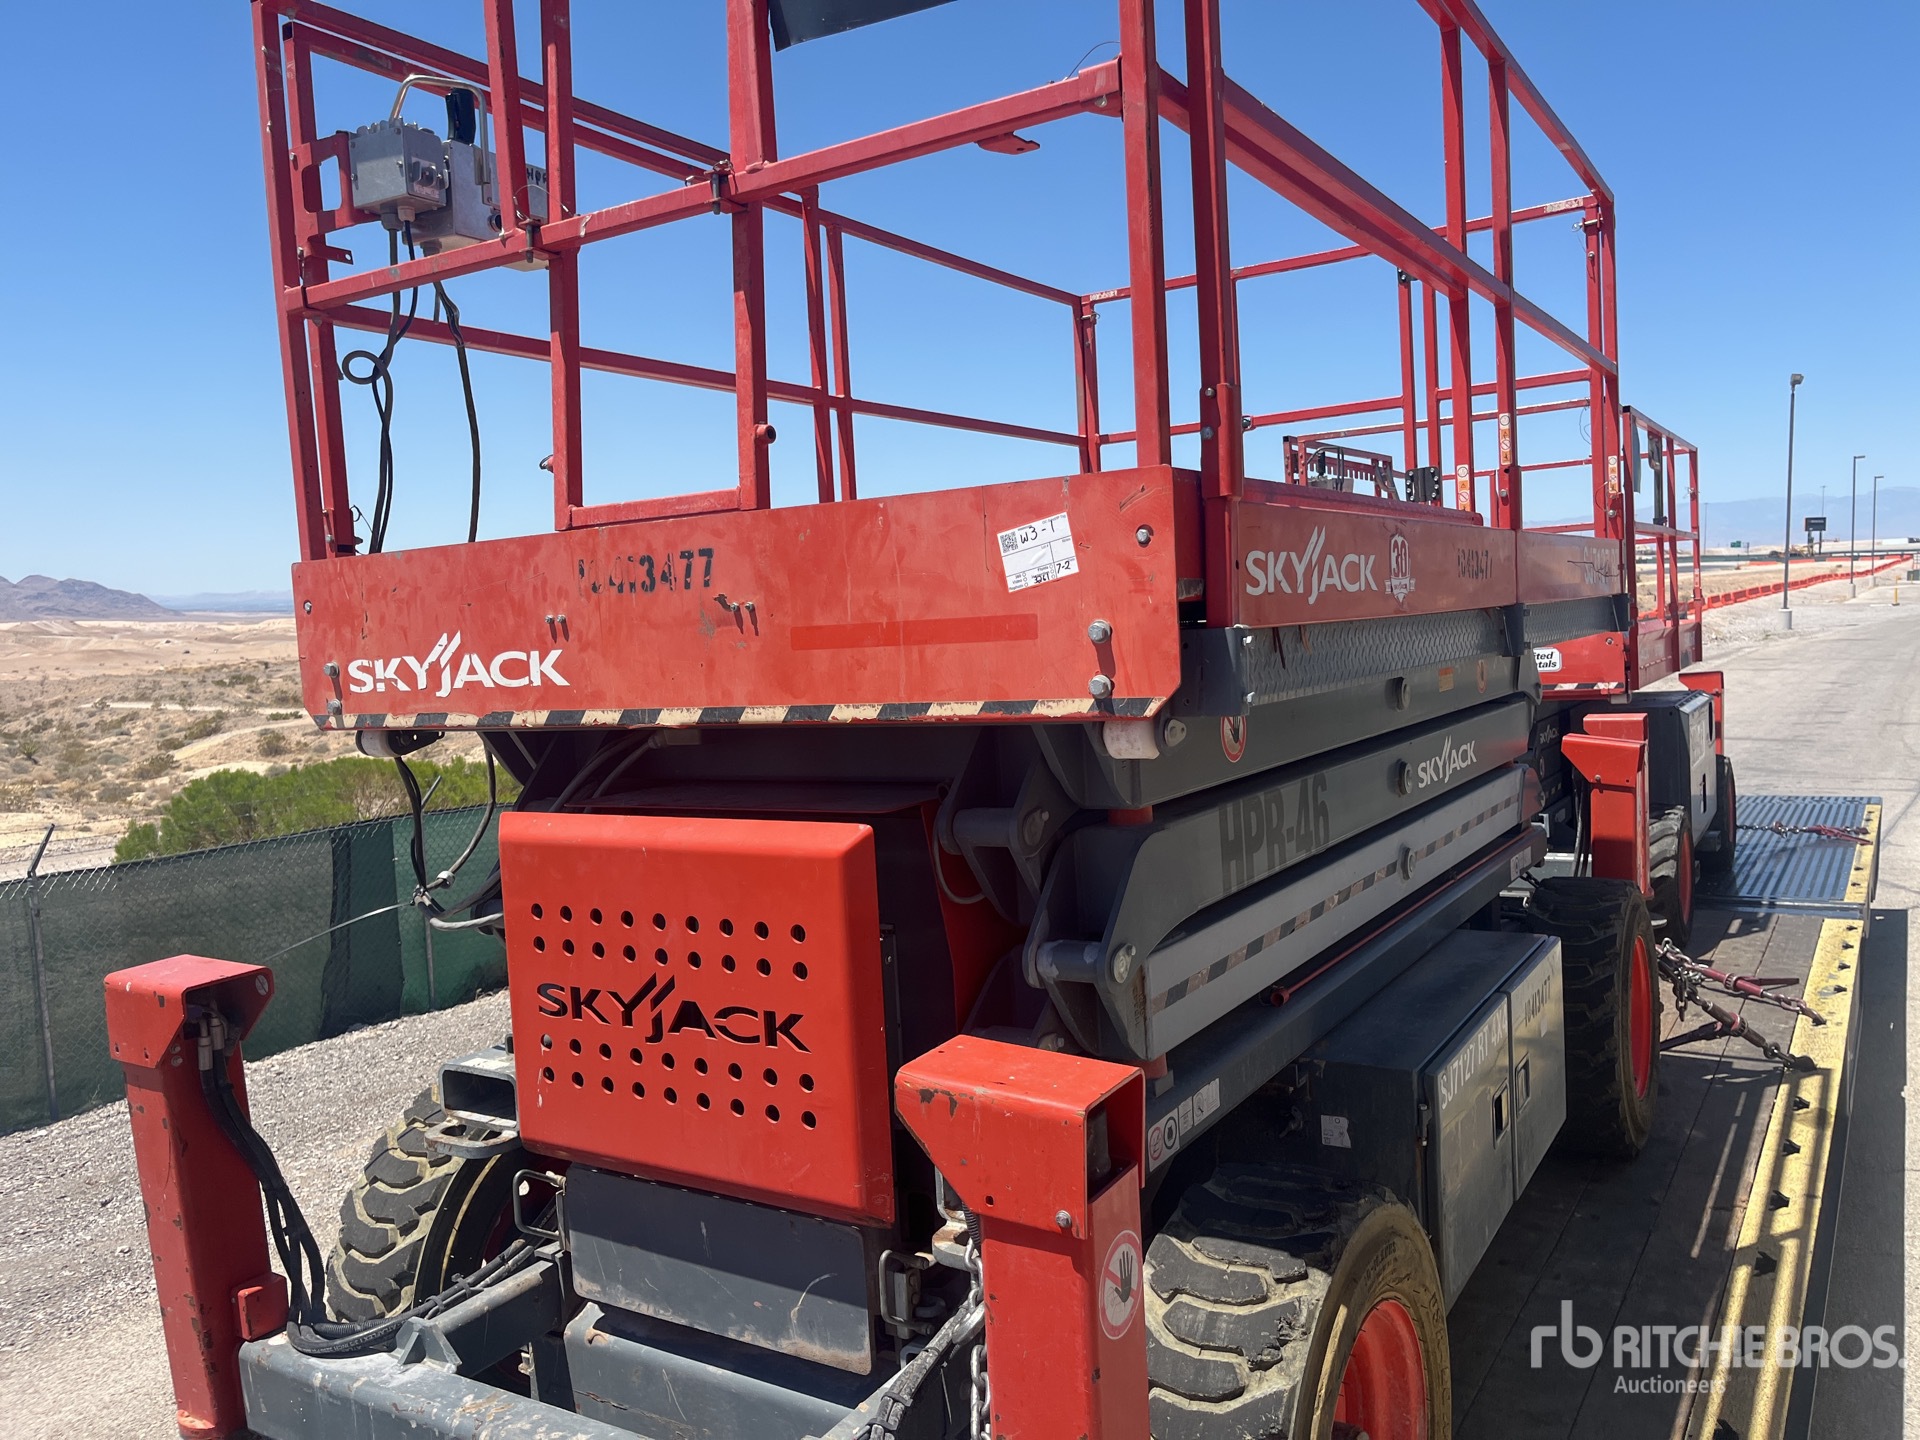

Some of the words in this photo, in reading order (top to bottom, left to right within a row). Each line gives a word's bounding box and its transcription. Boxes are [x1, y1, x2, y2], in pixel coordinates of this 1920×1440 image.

[1245, 525, 1378, 605] SKYJACK
[347, 629, 571, 698] SKYJACK
[1534, 651, 1554, 660] ted
[1417, 735, 1477, 789] SKYJACK
[1218, 771, 1330, 896] HPR-46
[536, 971, 812, 1054] SKYJACK
[1440, 1043, 1475, 1110] SJ7127
